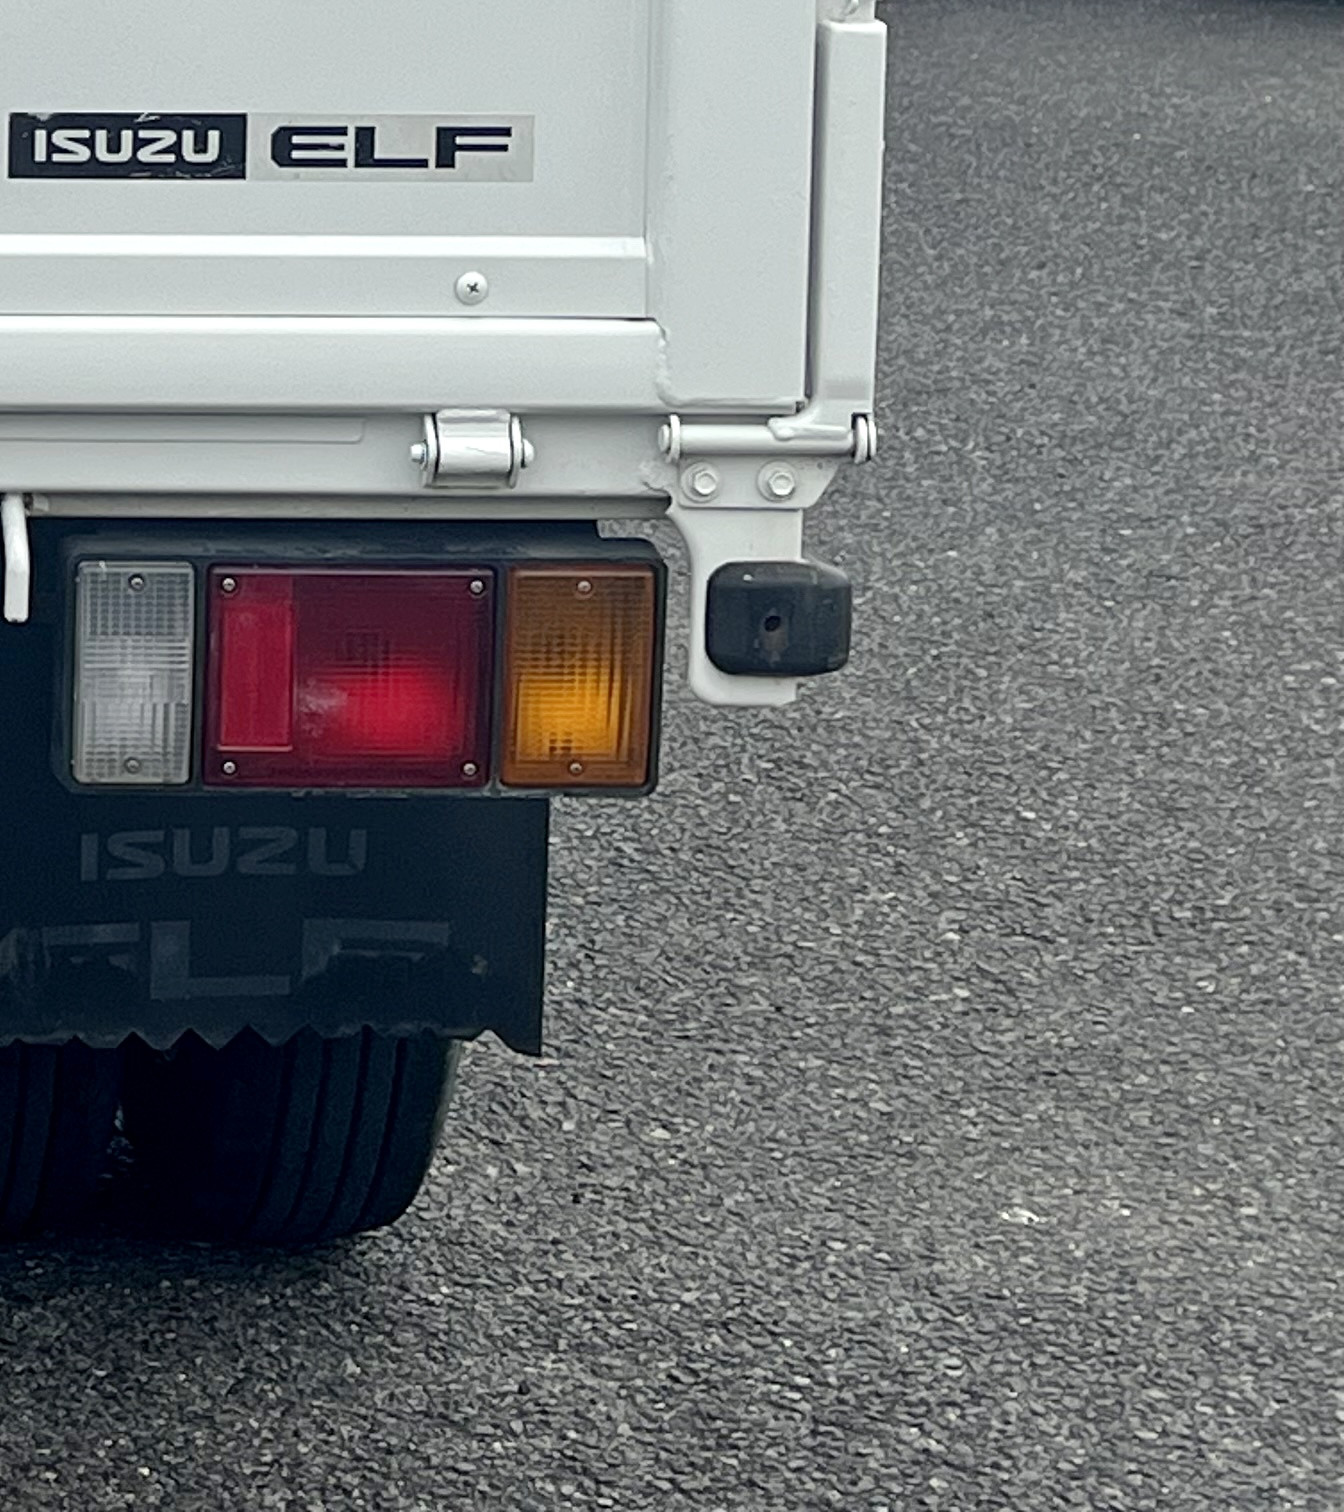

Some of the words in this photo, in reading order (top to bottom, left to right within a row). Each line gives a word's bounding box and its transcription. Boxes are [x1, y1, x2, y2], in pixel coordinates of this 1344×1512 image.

[33, 129, 221, 163] ISUZU
[270, 126, 512, 169] ELF
[80, 826, 368, 883] ISUZU
